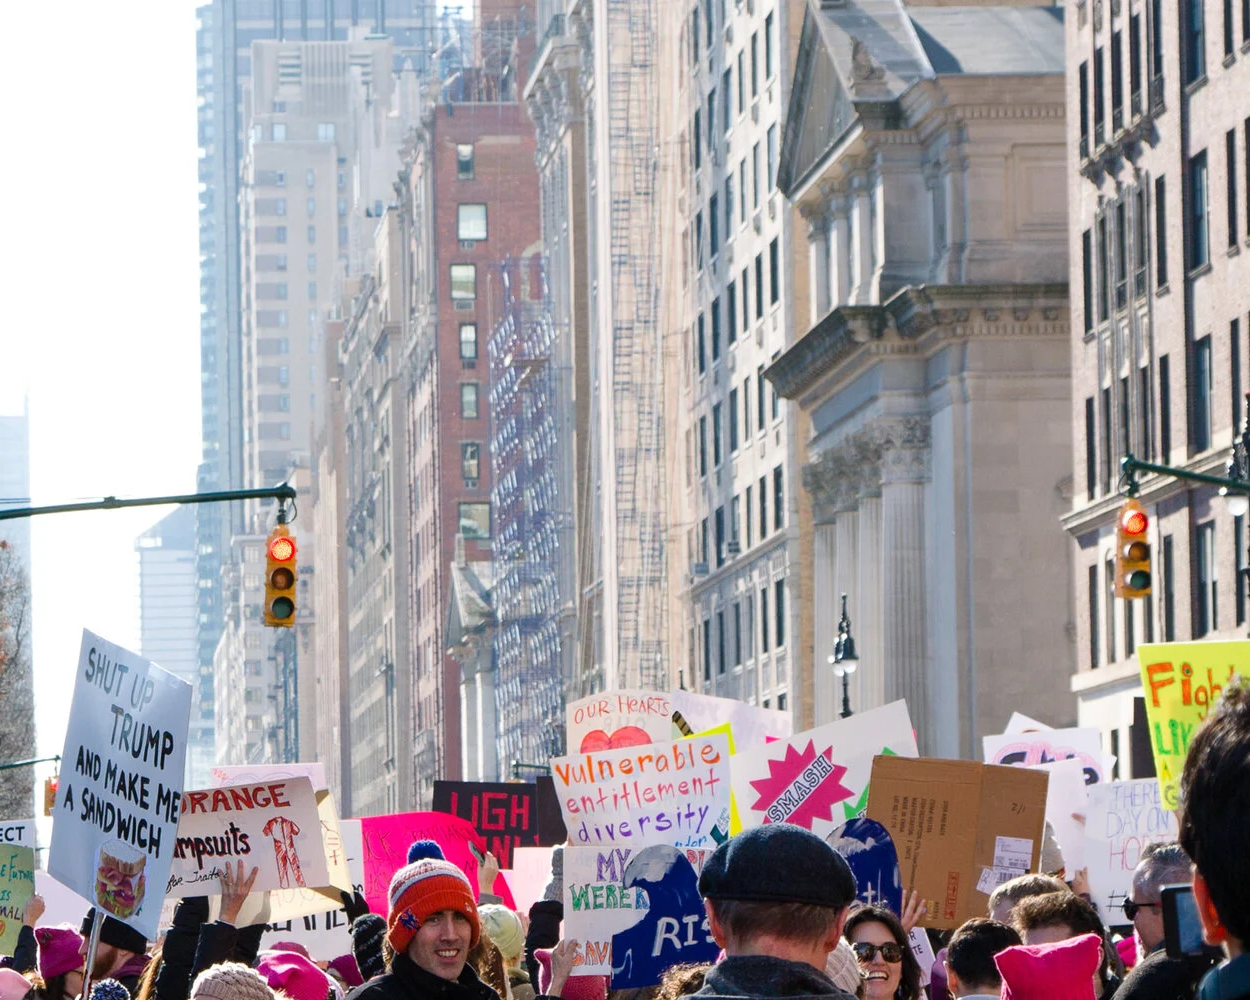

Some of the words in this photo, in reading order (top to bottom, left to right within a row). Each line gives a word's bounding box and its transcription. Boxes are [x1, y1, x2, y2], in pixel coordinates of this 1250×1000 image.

[85, 647, 129, 697] SHUT
[130, 673, 155, 712] UP
[574, 699, 611, 725] OUR
[110, 704, 174, 770] TRUMP
[75, 745, 101, 782] AND
[104, 759, 150, 810] MAKE
[155, 783, 181, 824] ME
[555, 743, 721, 787] Vulnerable
[1161, 758, 1173, 781] A
[566, 768, 720, 815] entitlement
[767, 754, 833, 823] SMASH
[63, 784, 75, 813] A
[80, 787, 162, 859] SANDWICH
[578, 802, 709, 844] diversity
[1106, 808, 1143, 839] DAY
[1147, 807, 1169, 834] ON
[596, 848, 632, 883] MY
[569, 883, 632, 912] WERE
